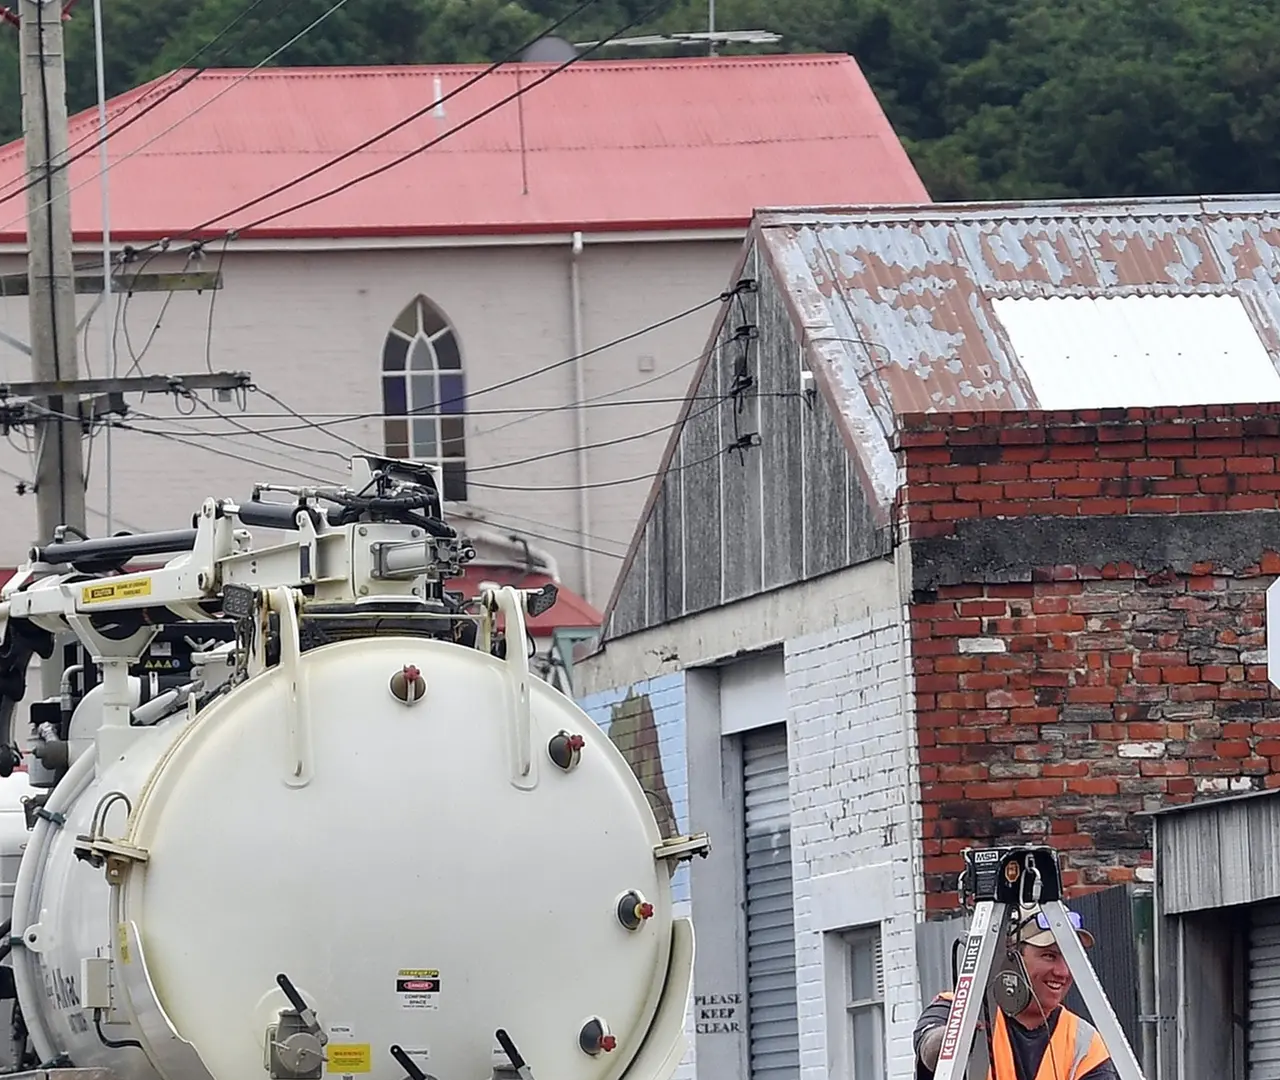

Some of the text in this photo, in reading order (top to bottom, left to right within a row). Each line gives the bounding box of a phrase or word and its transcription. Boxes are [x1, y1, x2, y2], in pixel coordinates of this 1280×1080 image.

[975, 852, 998, 861] MSA
[695, 994, 742, 1005] PLEASE
[943, 938, 981, 1057] KENNARDS HIRE
[701, 1008, 735, 1019] KEEP
[696, 1022, 744, 1034] CLEAR
